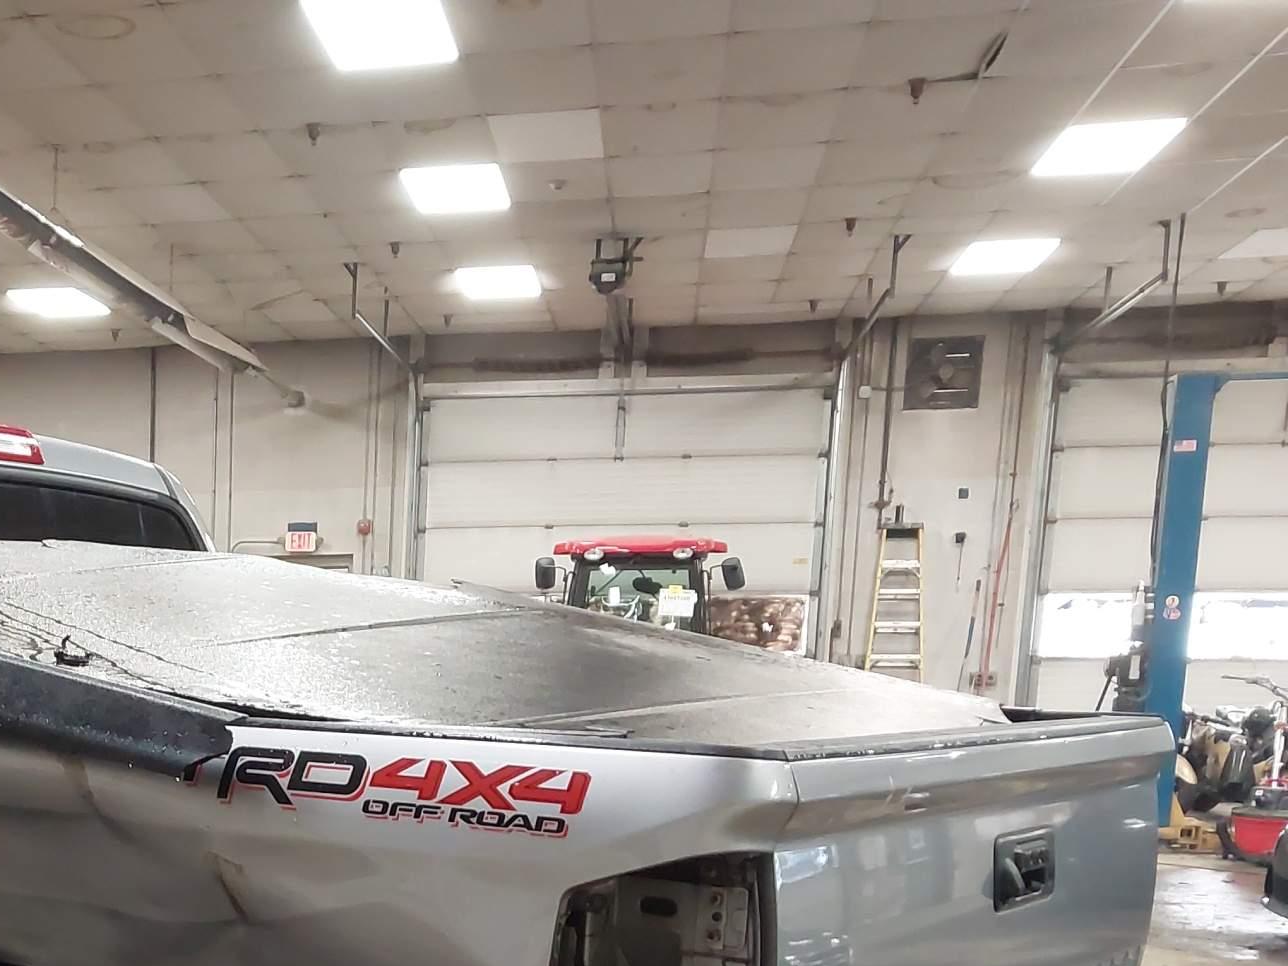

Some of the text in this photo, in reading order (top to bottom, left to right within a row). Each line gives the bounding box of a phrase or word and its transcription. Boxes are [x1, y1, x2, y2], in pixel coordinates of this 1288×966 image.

[290, 532, 313, 549] EXIT
[361, 799, 568, 838] OFF ROAD
